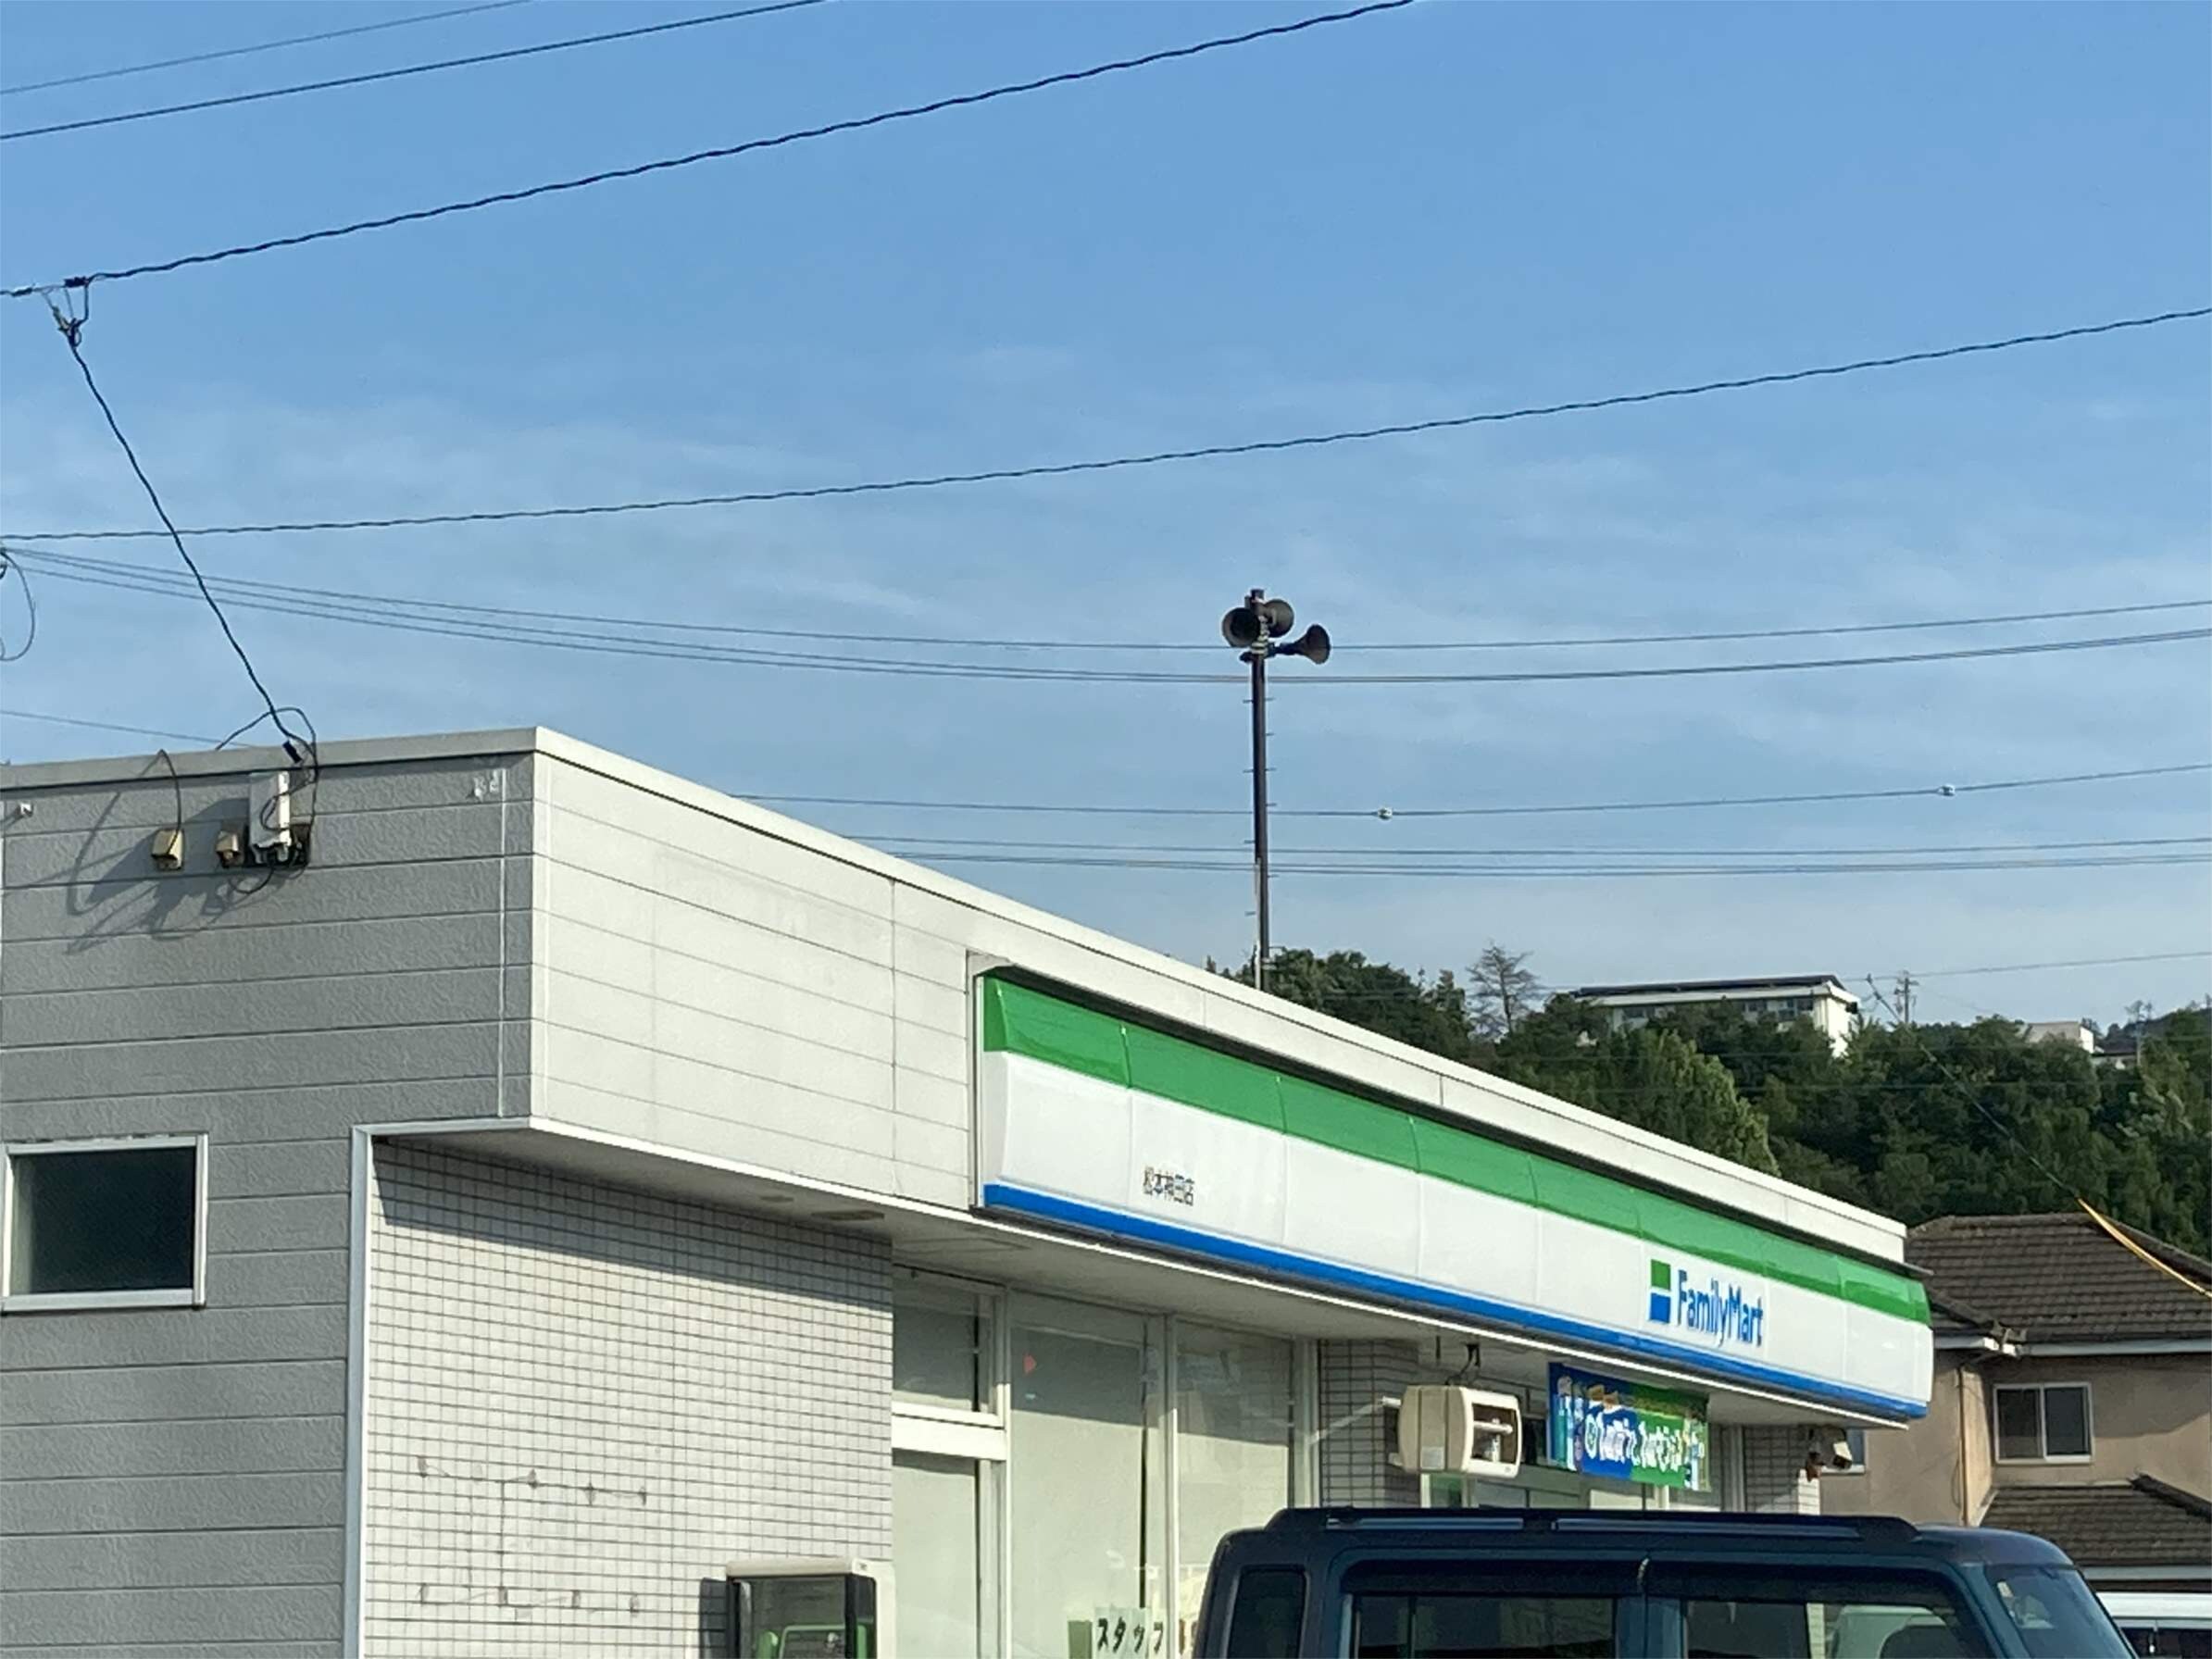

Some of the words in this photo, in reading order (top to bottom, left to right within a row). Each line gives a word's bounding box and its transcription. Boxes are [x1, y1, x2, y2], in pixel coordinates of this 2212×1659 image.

[1677, 1269, 1764, 1348] FamilyMart
[1097, 1616, 1164, 1654] スタッフ
